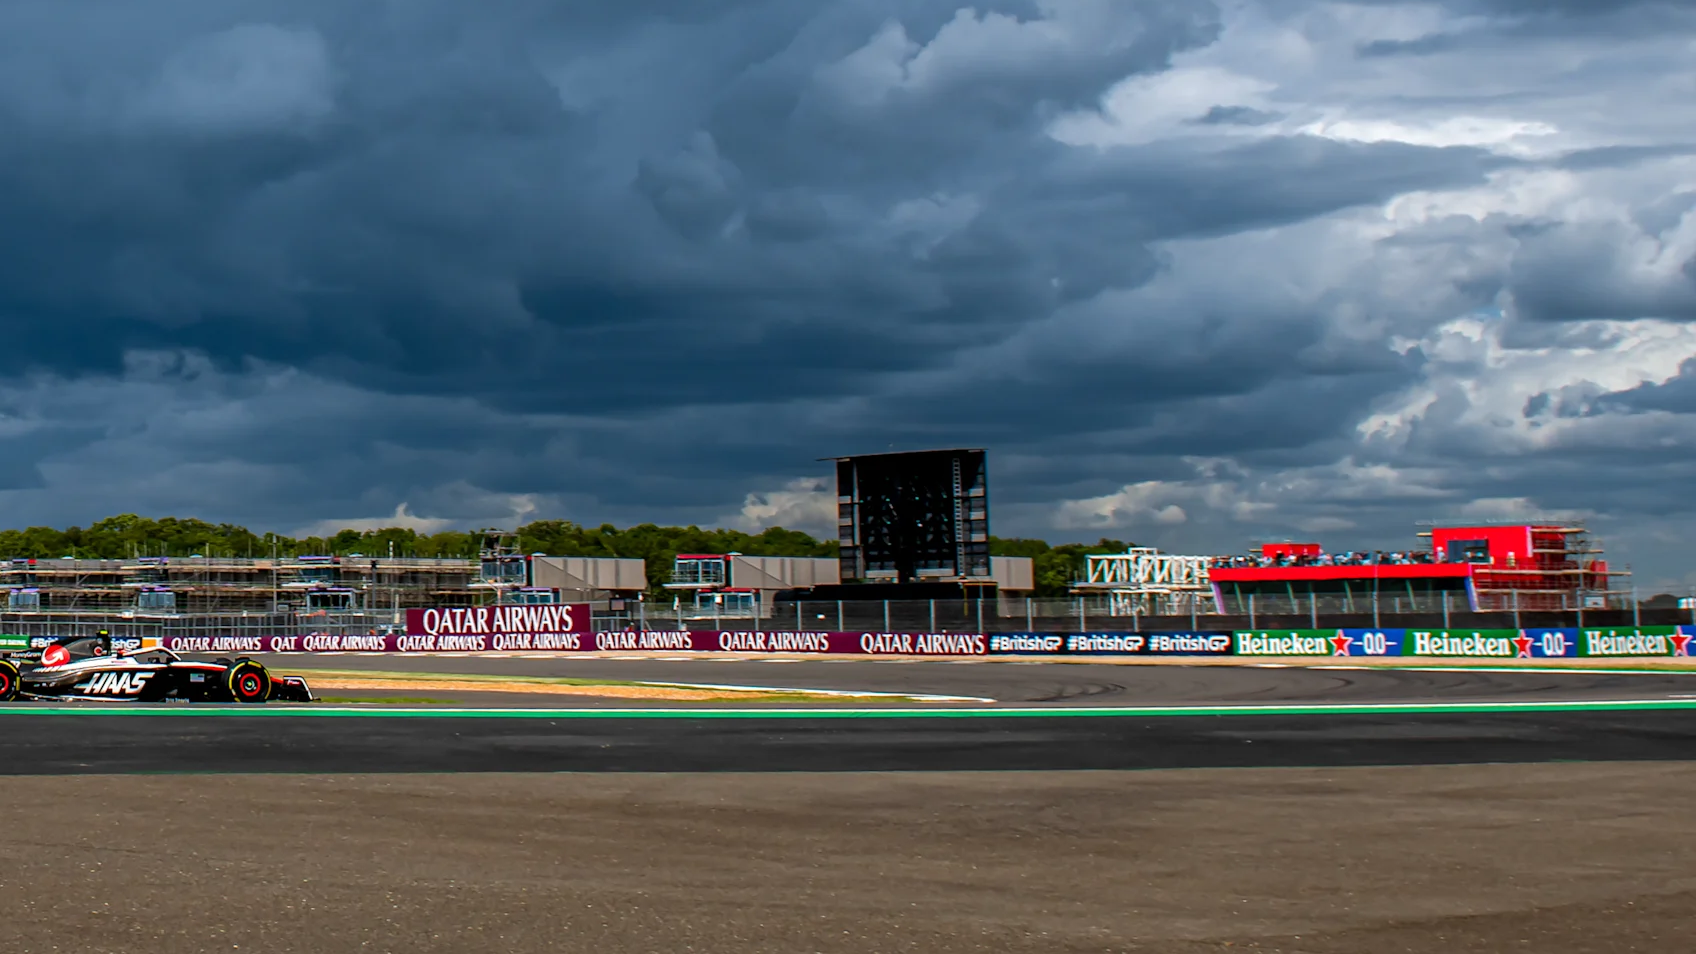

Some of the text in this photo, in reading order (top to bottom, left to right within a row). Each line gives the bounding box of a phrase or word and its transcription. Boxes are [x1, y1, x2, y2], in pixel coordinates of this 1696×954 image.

[422, 605, 573, 635] QATAR AIRWAYS
[171, 636, 262, 651] QATAR AIRWAYS
[270, 636, 298, 652] QAT
[303, 635, 386, 651] QATAR AIRWAYS
[397, 635, 486, 651] QATAR AIRWAYS
[492, 634, 581, 650] QATAR AIRWAYS
[595, 632, 692, 650] QATAR AIRWAYS
[718, 632, 829, 651] QATAR AIRWAYS
[860, 633, 985, 654] QATAR AIRWAYS
[1237, 632, 1328, 654] Heineken
[1413, 632, 1511, 655] Heineken
[1585, 630, 1668, 655] Heineken
[10, 651, 42, 659] MoneyGram
[74, 671, 156, 694] HAAS
